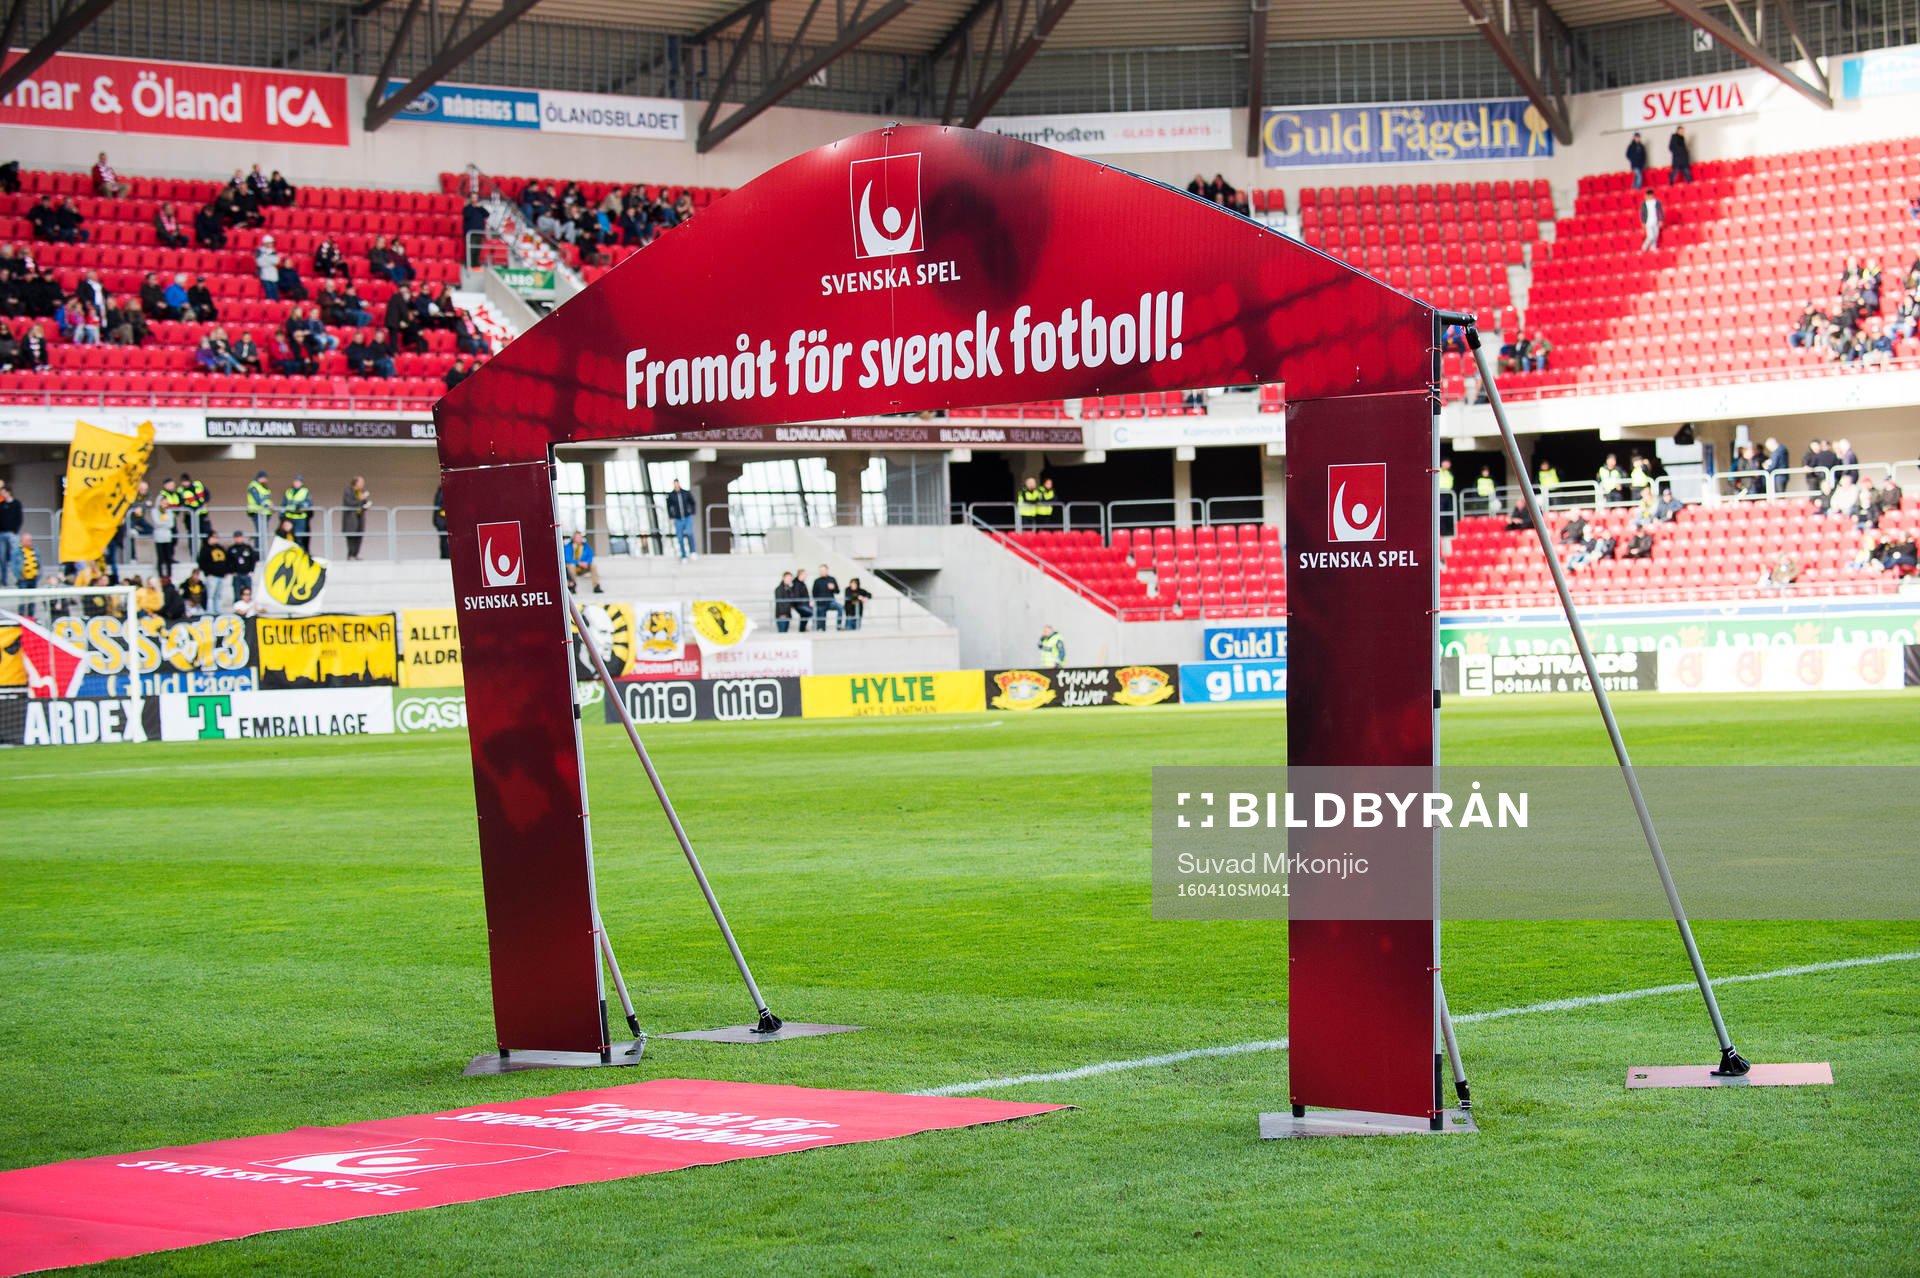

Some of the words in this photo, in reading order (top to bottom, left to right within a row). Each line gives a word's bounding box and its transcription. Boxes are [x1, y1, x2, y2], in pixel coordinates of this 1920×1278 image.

[90, 76, 123, 114] &
[131, 71, 243, 123] Öland
[265, 85, 333, 129] ICA
[1643, 82, 1744, 120] SVEVIA
[545, 102, 679, 131] ÖLANDSBLADET
[1264, 111, 1370, 158] Guld
[1379, 106, 1521, 160] Fågeln
[820, 266, 912, 296] SVENSKA
[915, 260, 961, 286] SPEL
[626, 333, 777, 411] Framåt
[785, 328, 853, 396] för
[857, 310, 1004, 389] svensk
[1009, 290, 1185, 374] fotboll!
[207, 418, 296, 437] BILDVÄXLARNA
[1299, 551, 1374, 569] SVENSKA
[1378, 550, 1419, 567] SPEL
[464, 593, 519, 610] SVENSKA
[521, 591, 553, 607] SPEL
[262, 622, 391, 646] GULIGANERNA
[1210, 632, 1273, 659] Guld
[851, 676, 935, 704] HYLTE
[24, 699, 148, 746] ARDEX
[239, 714, 368, 738] EMBALLAGE
[434, 1112, 630, 1133] svensk
[117, 1161, 314, 1184] SVENSKA
[303, 1179, 420, 1196] SPEL
